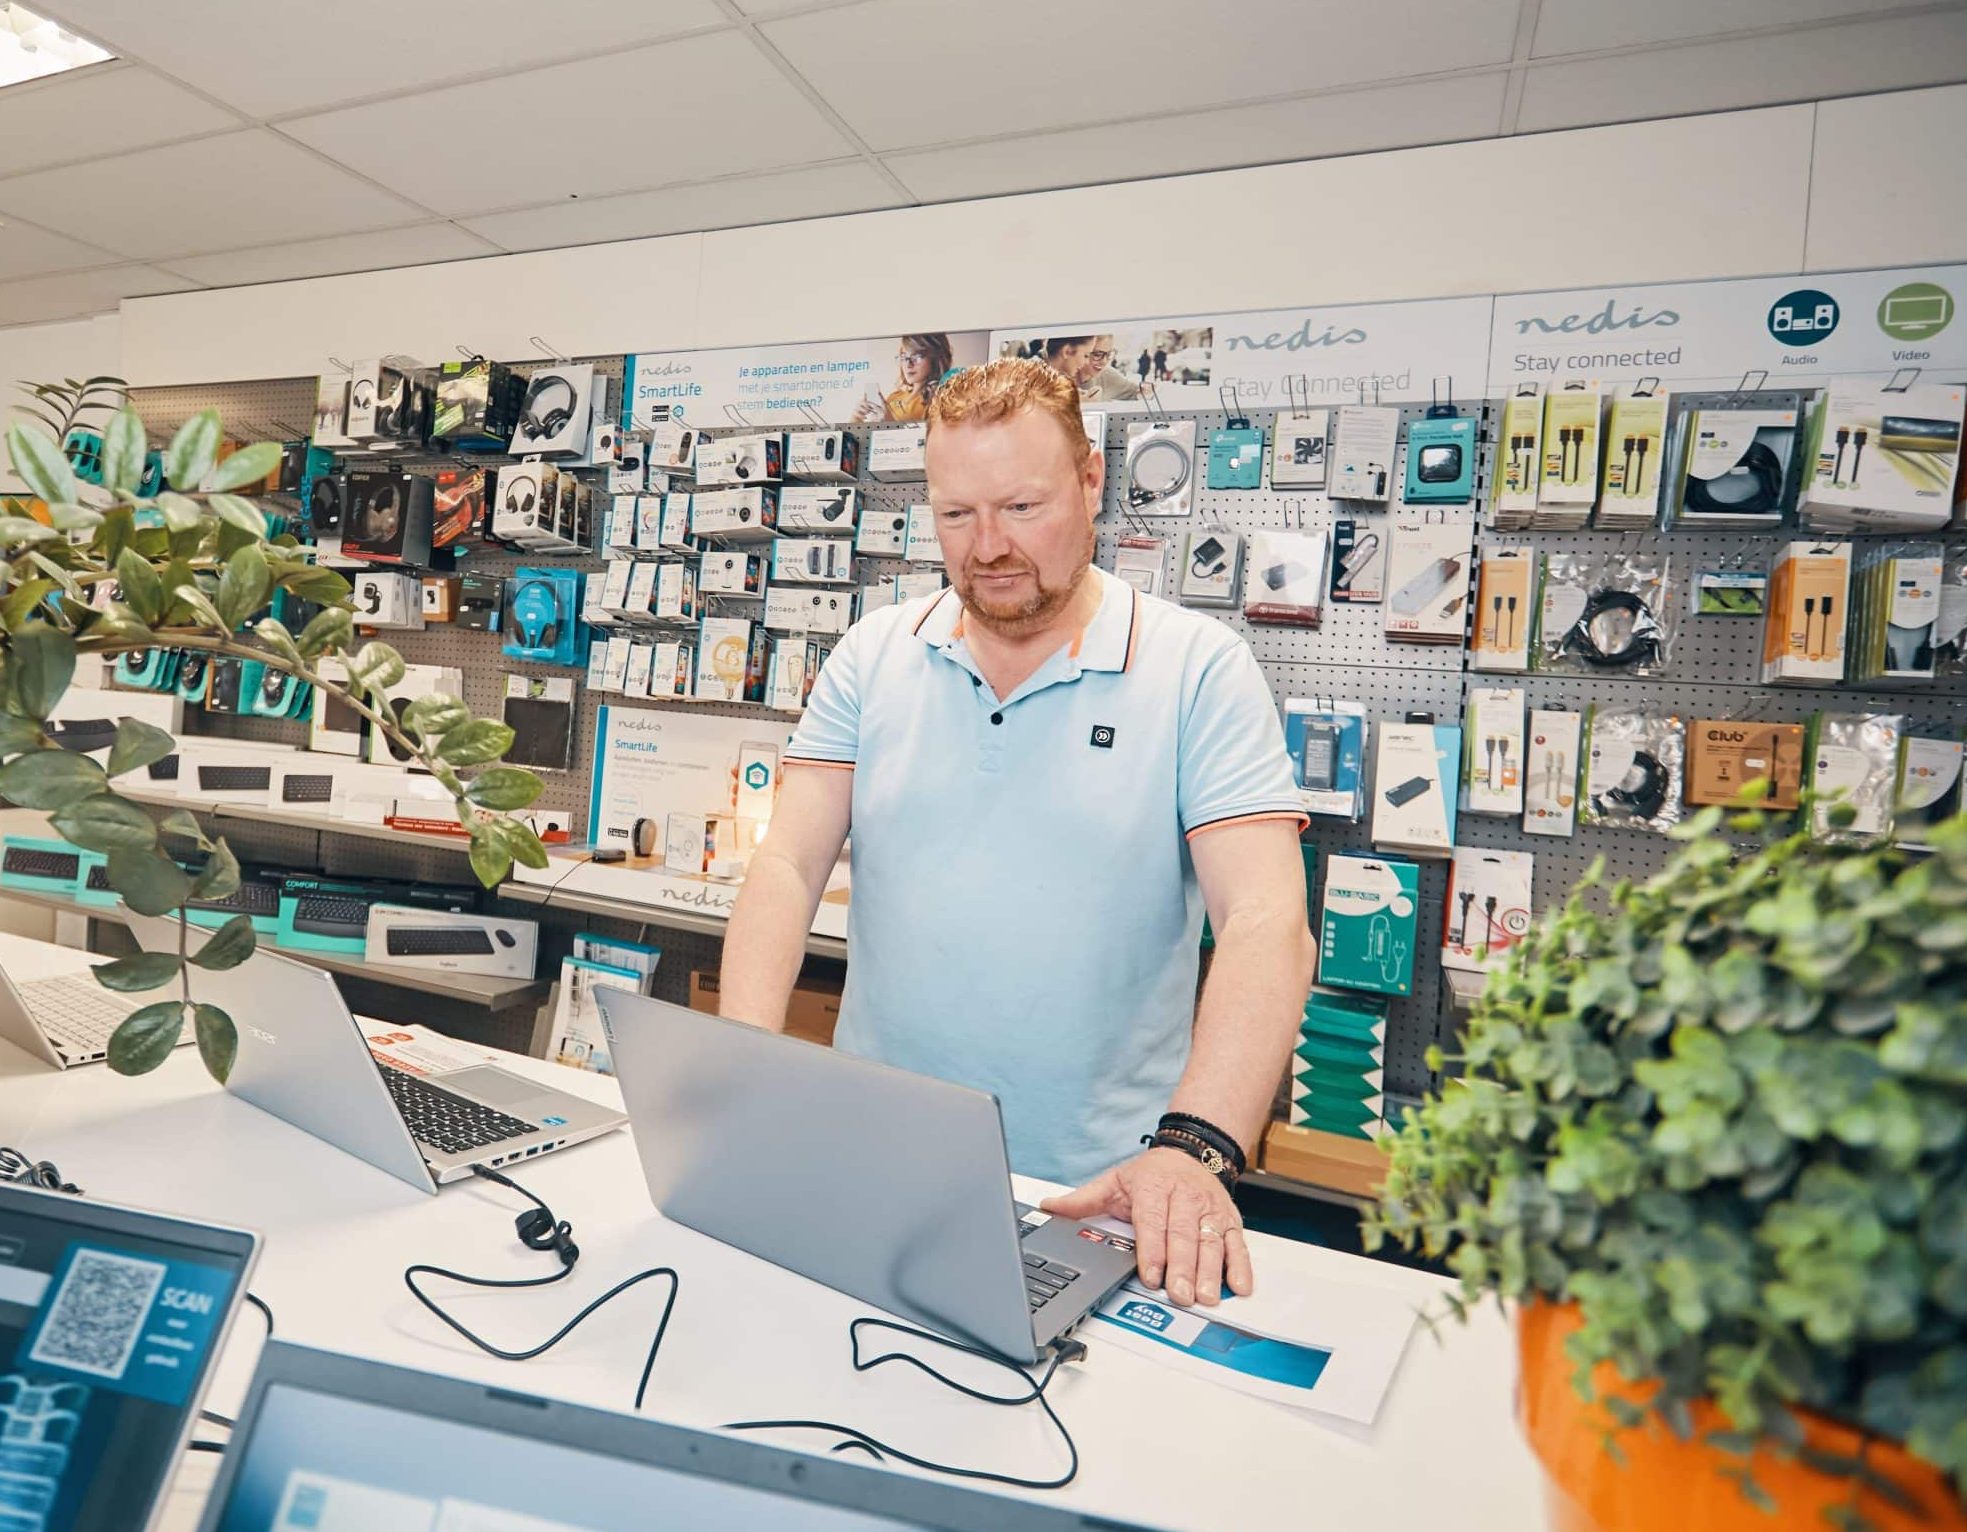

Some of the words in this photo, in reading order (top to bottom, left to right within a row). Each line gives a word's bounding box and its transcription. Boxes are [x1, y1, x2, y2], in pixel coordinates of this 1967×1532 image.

[1514, 300, 1681, 335] nedis
[1225, 319, 1367, 351] nedis
[1514, 353, 1561, 373] Stay
[1566, 347, 1681, 370] connected
[1782, 354, 1819, 366] Audio
[1892, 349, 1931, 361] Video
[640, 361, 692, 376] nedis
[739, 366, 750, 378] Je
[752, 364, 807, 378] apparaten
[810, 363, 824, 373] en
[827, 359, 870, 374] lampen
[639, 382, 702, 399] SmartLife
[738, 382, 759, 394] met
[760, 380, 771, 395] je
[772, 378, 840, 394] smartphone
[842, 377, 855, 389] of
[1222, 376, 1272, 401] Stay
[737, 398, 764, 411] stem
[766, 396, 823, 410] bedienen?
[618, 718, 662, 731] nedis
[1707, 730, 1744, 743] Club
[615, 739, 658, 752] SmartLife
[285, 880, 319, 889] COMFORT
[159, 1286, 214, 1315] SCAN
